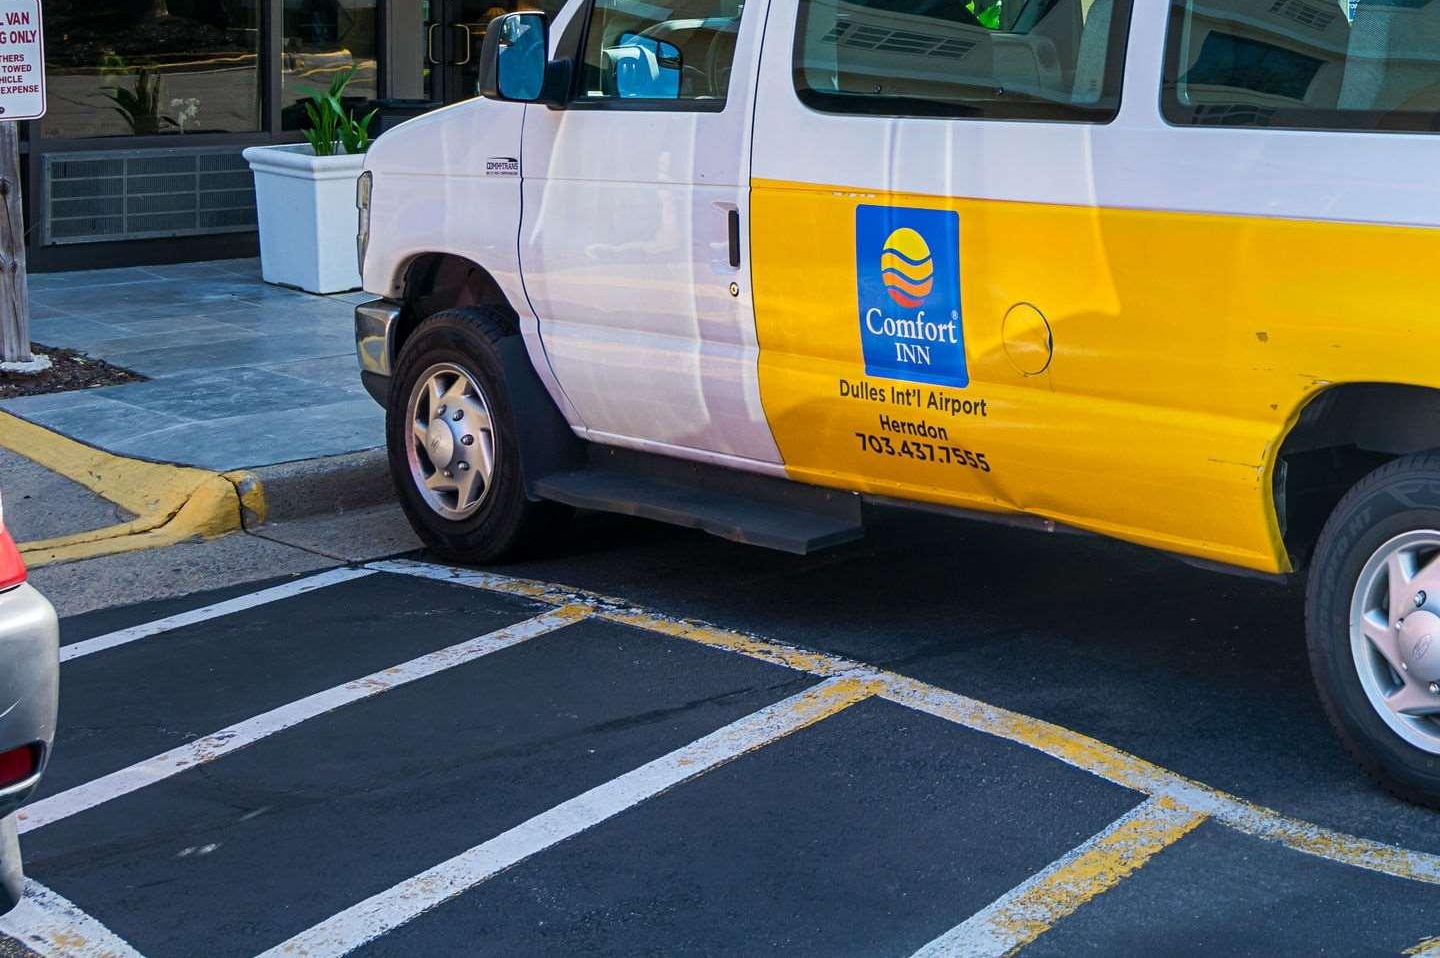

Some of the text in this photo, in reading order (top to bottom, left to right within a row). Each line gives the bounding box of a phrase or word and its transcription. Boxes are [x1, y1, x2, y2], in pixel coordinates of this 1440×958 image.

[6, 11, 30, 25] VAN
[10, 30, 37, 44] ONLY
[2, 64, 32, 73] TOWED
[1, 85, 39, 95] EXPENSE
[866, 307, 958, 344] Comfort
[895, 342, 931, 366] INN
[839, 379, 886, 402] Dulles
[927, 391, 987, 417] Airport
[879, 414, 949, 441] Herndon
[855, 432, 991, 473] 703.437.7555
